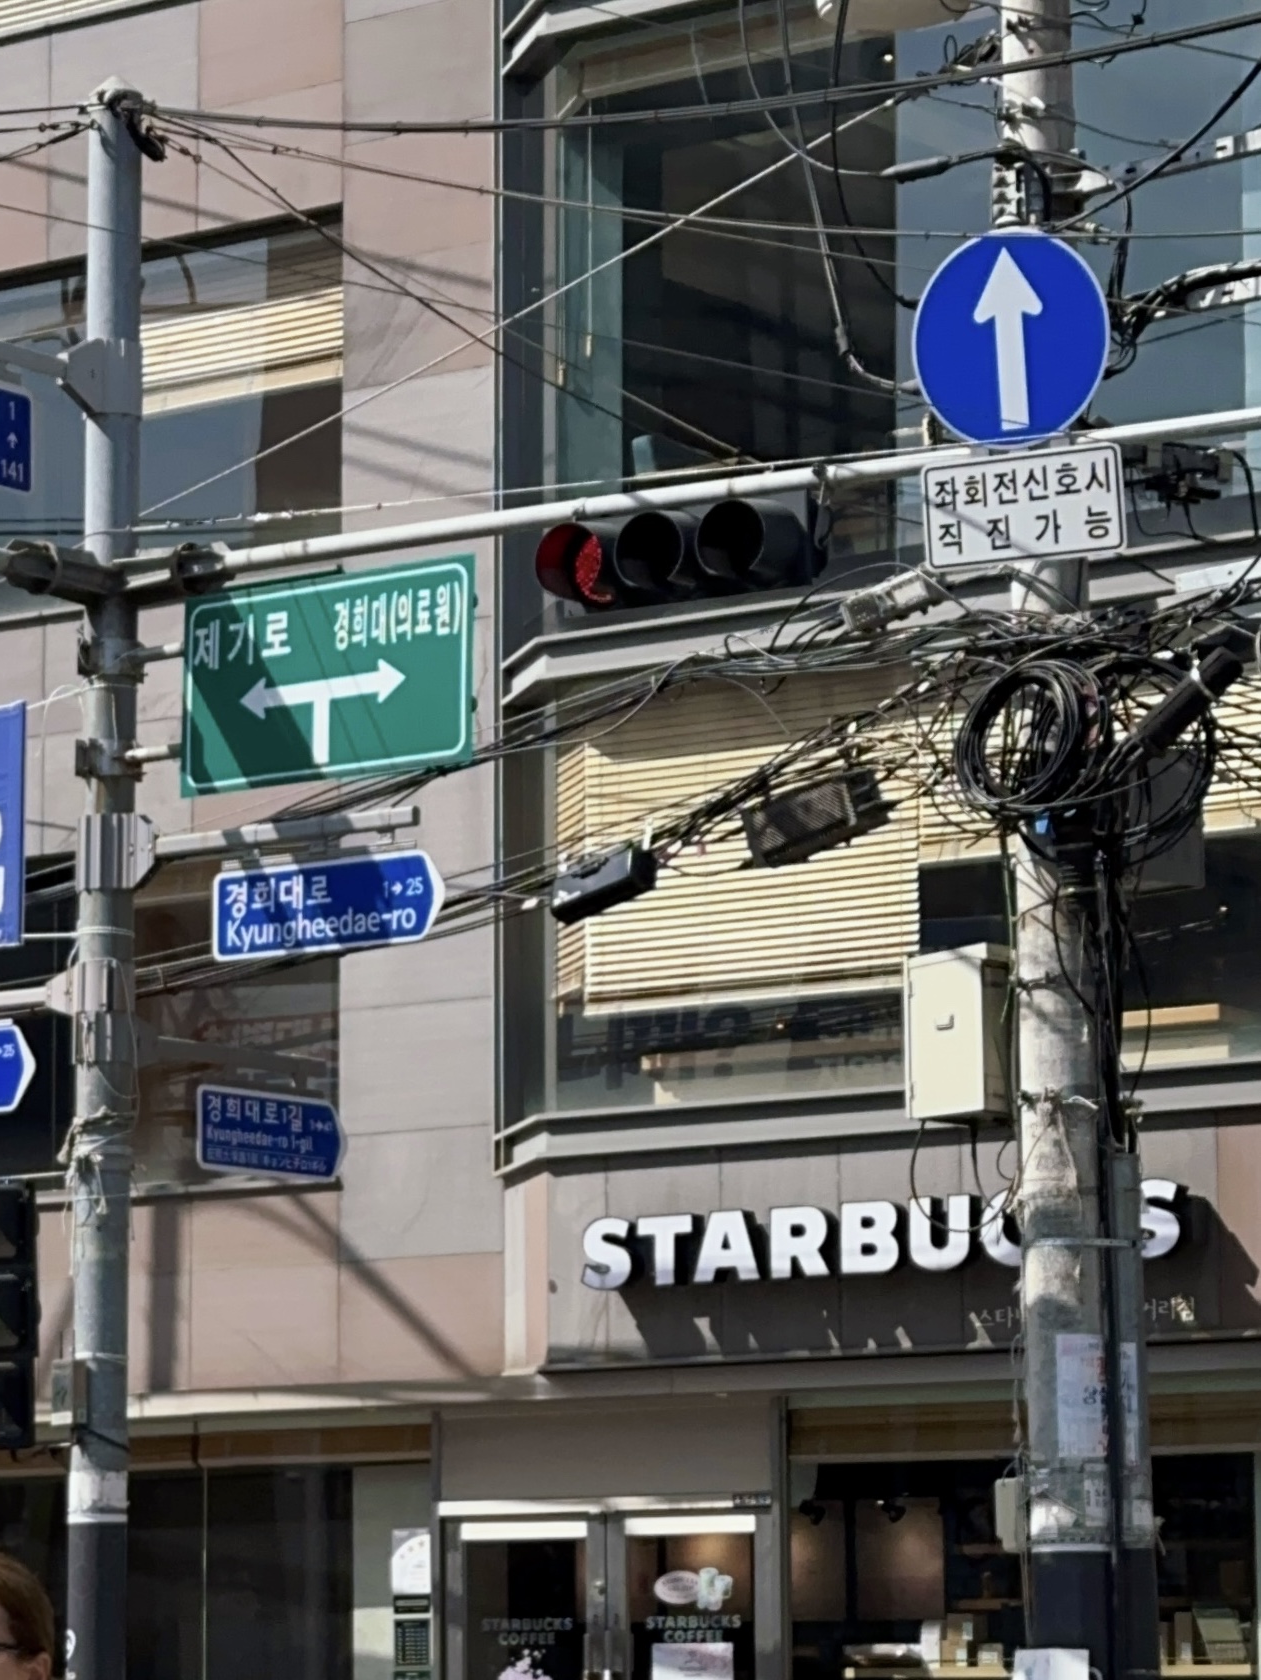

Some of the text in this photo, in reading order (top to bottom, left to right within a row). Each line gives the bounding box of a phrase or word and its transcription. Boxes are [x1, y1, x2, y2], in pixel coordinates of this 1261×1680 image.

[9, 401, 16, 420] 1
[0, 459, 24, 482] 141
[933, 457, 1112, 512] 좌회전신호시
[334, 581, 461, 651] 경희대(의료원)
[194, 611, 292, 669] 제기로
[225, 875, 332, 919] 경희대로
[406, 876, 424, 896] 25
[226, 906, 417, 953] Kyungheedae-ro
[2, 1044, 16, 1058] 25
[207, 1095, 303, 1132] 경희대로1길
[206, 1124, 313, 1154] Kyungheedae-ro 1-gil
[582, 1178, 1181, 1290] STARBUCS
[481, 1617, 573, 1631] STARBUCKS
[646, 1615, 741, 1630] STARBUCKS
[499, 1632, 555, 1646] COFFEE
[663, 1629, 724, 1643] COFFEE
